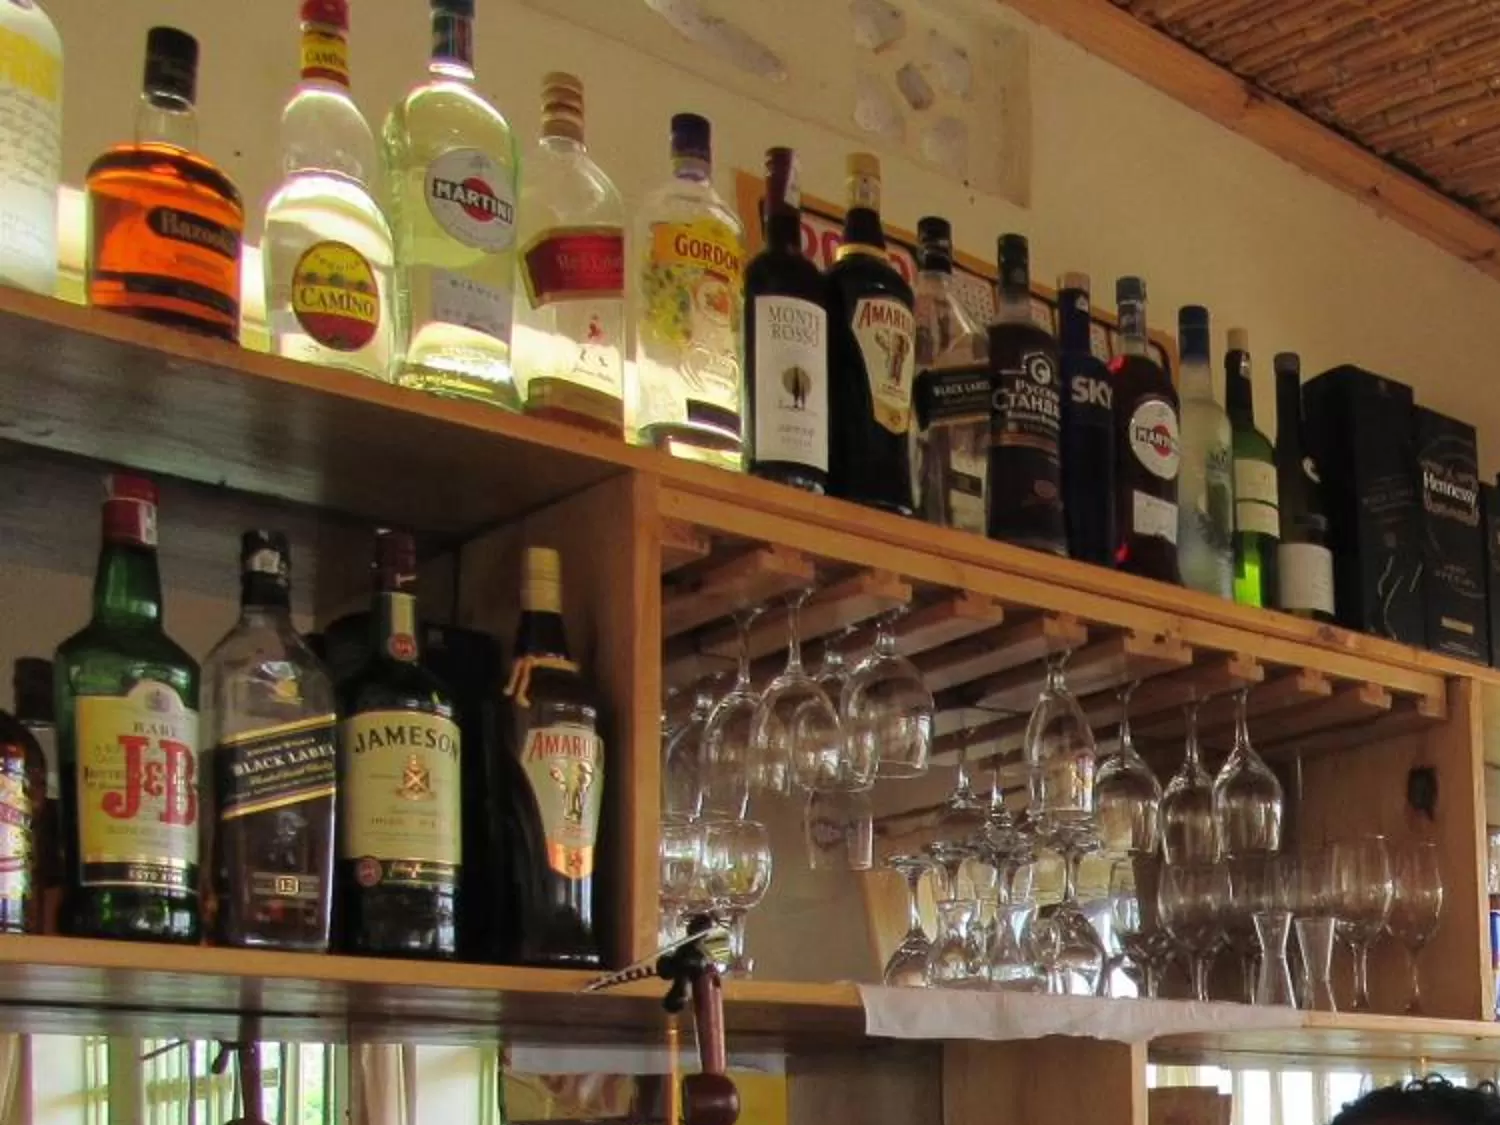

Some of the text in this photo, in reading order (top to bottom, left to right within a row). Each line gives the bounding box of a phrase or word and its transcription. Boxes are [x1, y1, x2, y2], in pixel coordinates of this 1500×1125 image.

[437, 181, 513, 224] MARTINI
[300, 287, 375, 314] CAMINO
[1423, 470, 1479, 505] Hennessy
[232, 753, 286, 776] BLACK
[288, 743, 336, 764] LABEL
[355, 725, 459, 763] JAMESON
[101, 735, 199, 826] J&B
